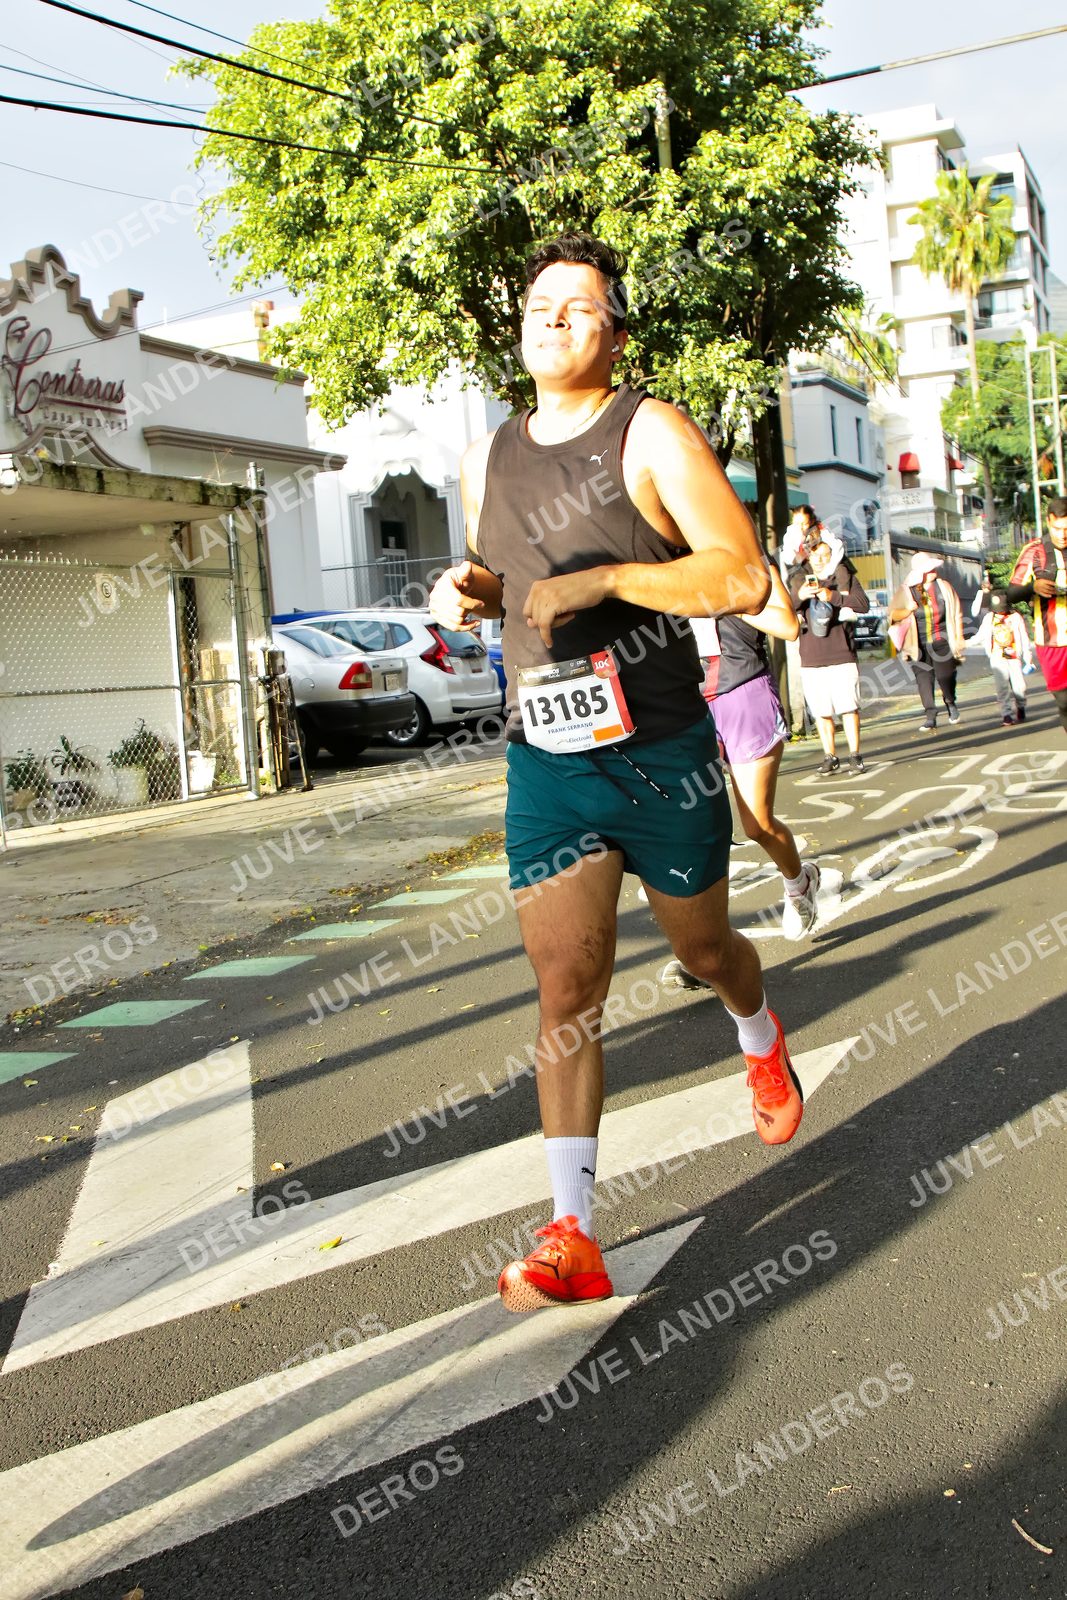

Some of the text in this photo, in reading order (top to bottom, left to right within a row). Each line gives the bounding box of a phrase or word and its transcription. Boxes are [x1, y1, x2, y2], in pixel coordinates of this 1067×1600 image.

[2, 316, 125, 415] Contreras
[524, 684, 608, 727] 13185
[547, 722, 593, 734] FRANK SERRANO
